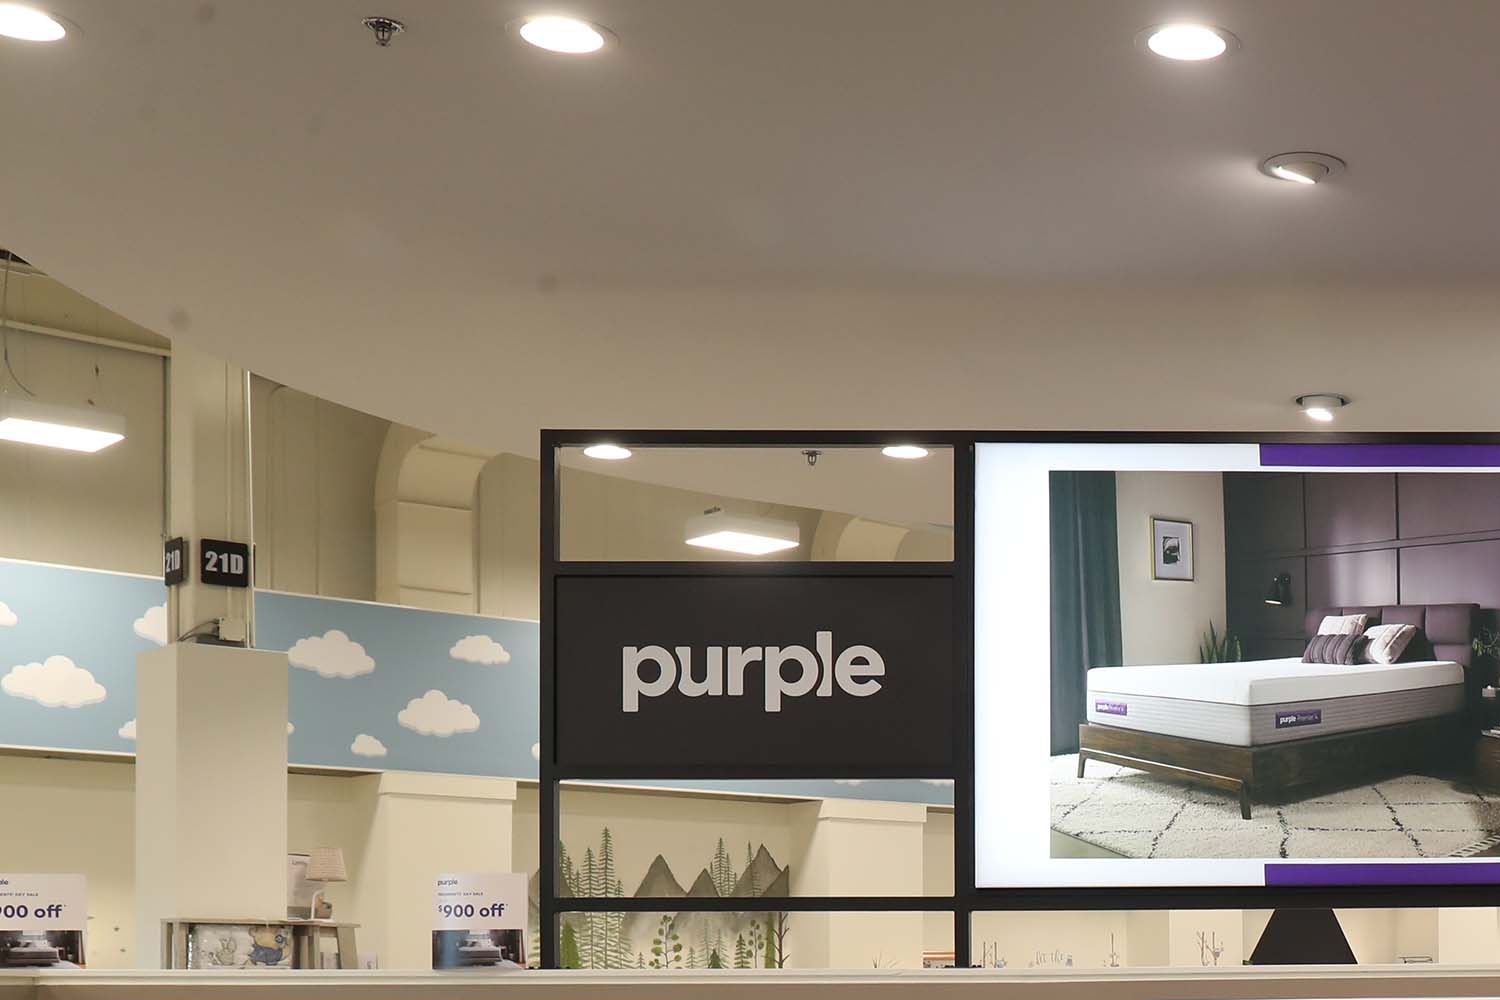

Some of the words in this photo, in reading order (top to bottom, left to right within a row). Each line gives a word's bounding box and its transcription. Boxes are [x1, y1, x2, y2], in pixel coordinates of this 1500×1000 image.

[165, 549, 181, 573] 21D
[205, 550, 244, 575] 21D
[622, 630, 886, 713] purple
[438, 904, 474, 918] $900
